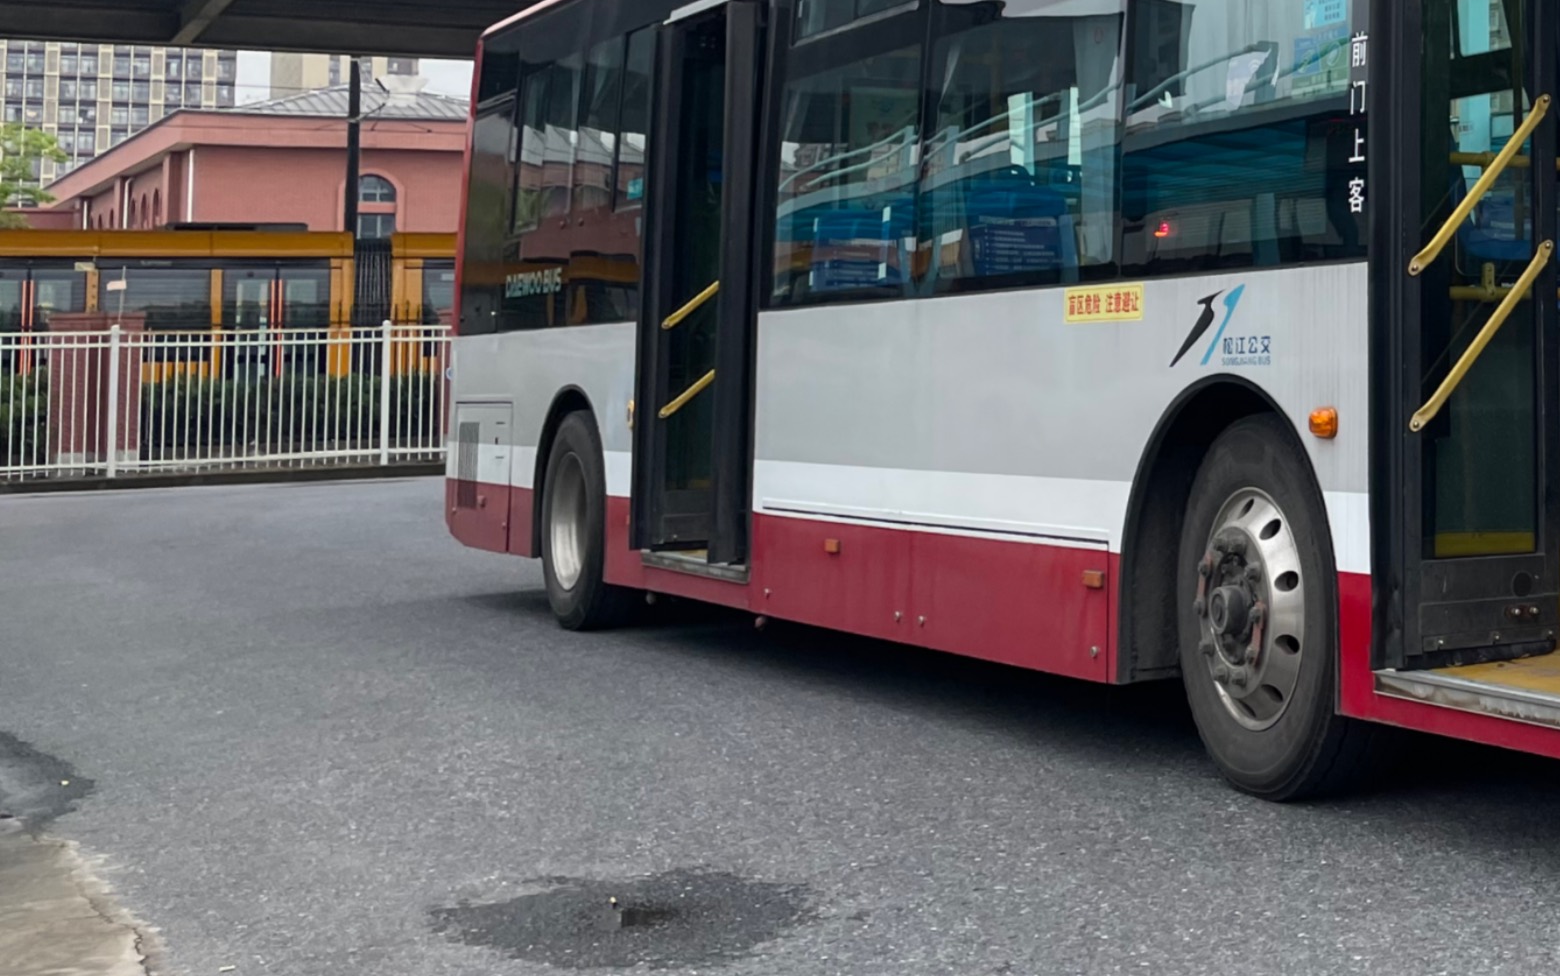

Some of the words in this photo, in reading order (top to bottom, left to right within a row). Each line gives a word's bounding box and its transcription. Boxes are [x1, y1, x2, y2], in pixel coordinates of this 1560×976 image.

[1348, 31, 1368, 213] 前门上客
[1068, 293, 1101, 316] 盲区危险
[1105, 291, 1140, 313] 注意避让
[1222, 335, 1272, 355] 松江公交
[1258, 355, 1271, 366] BUS
